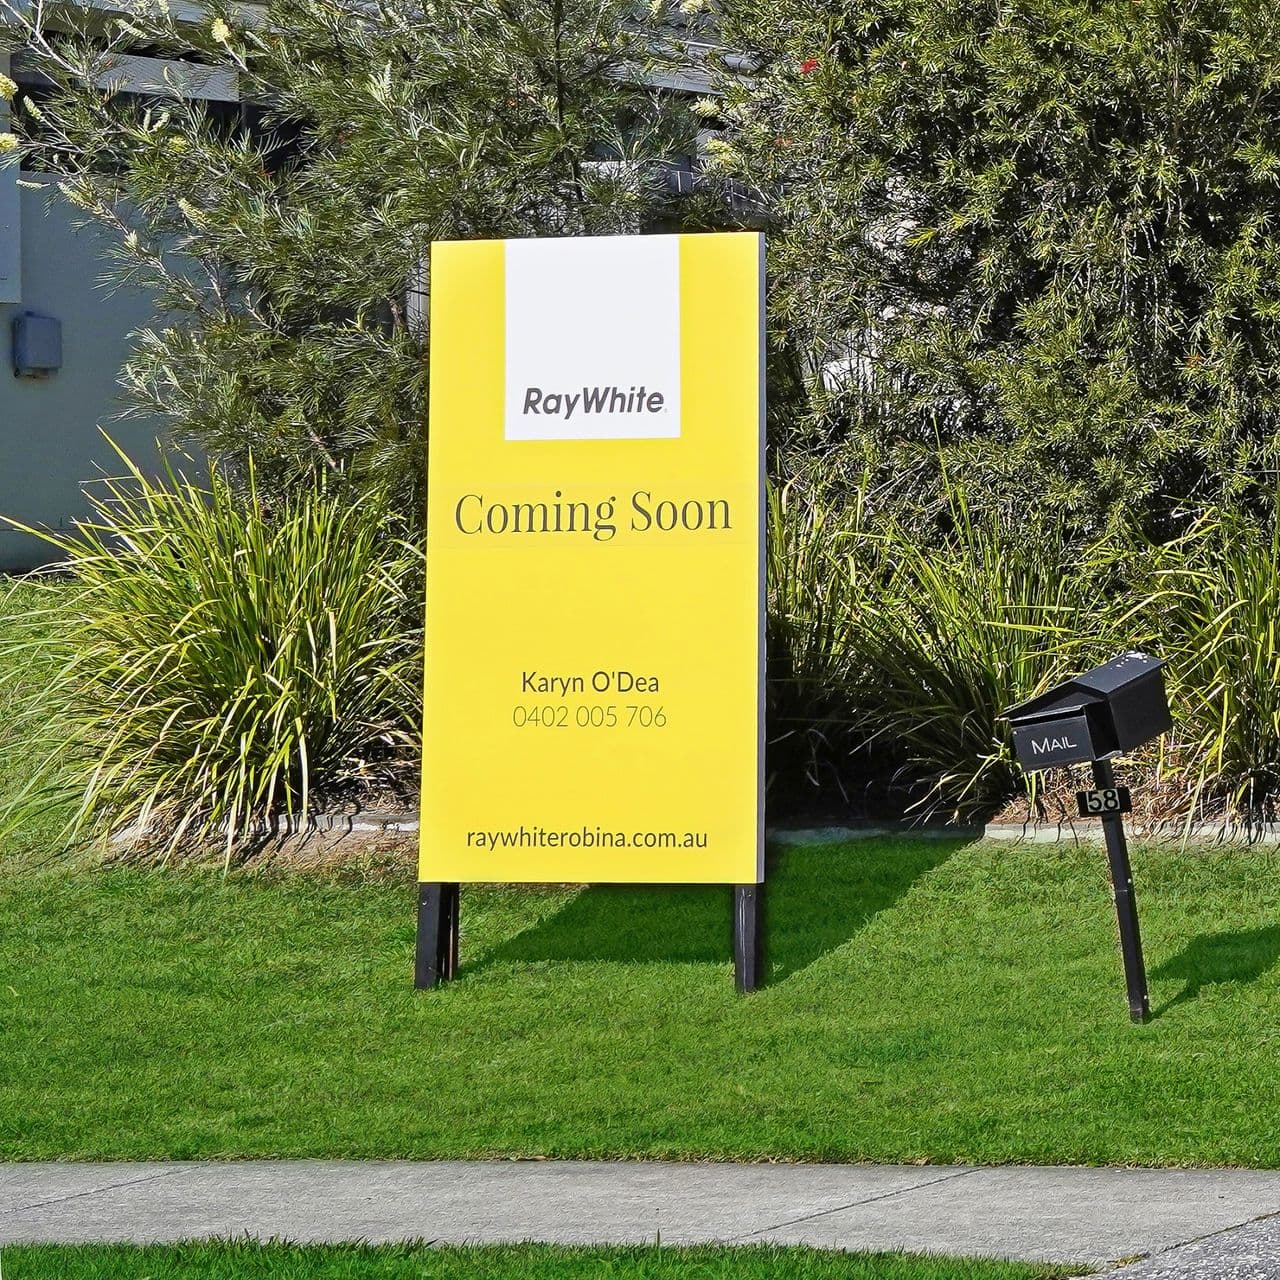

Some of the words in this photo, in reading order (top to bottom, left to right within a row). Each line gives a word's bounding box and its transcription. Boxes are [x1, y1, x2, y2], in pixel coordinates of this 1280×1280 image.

[455, 490, 617, 542] Coming
[630, 490, 732, 532] Soon
[522, 671, 584, 698] Karyn
[592, 670, 660, 693] O'Dea
[512, 704, 569, 728] 0402
[575, 705, 618, 728] 005
[625, 705, 667, 727] 706
[1031, 736, 1077, 756] MAIL
[1087, 788, 1121, 814] 58
[466, 824, 709, 852] raywhiterobina.com.au
